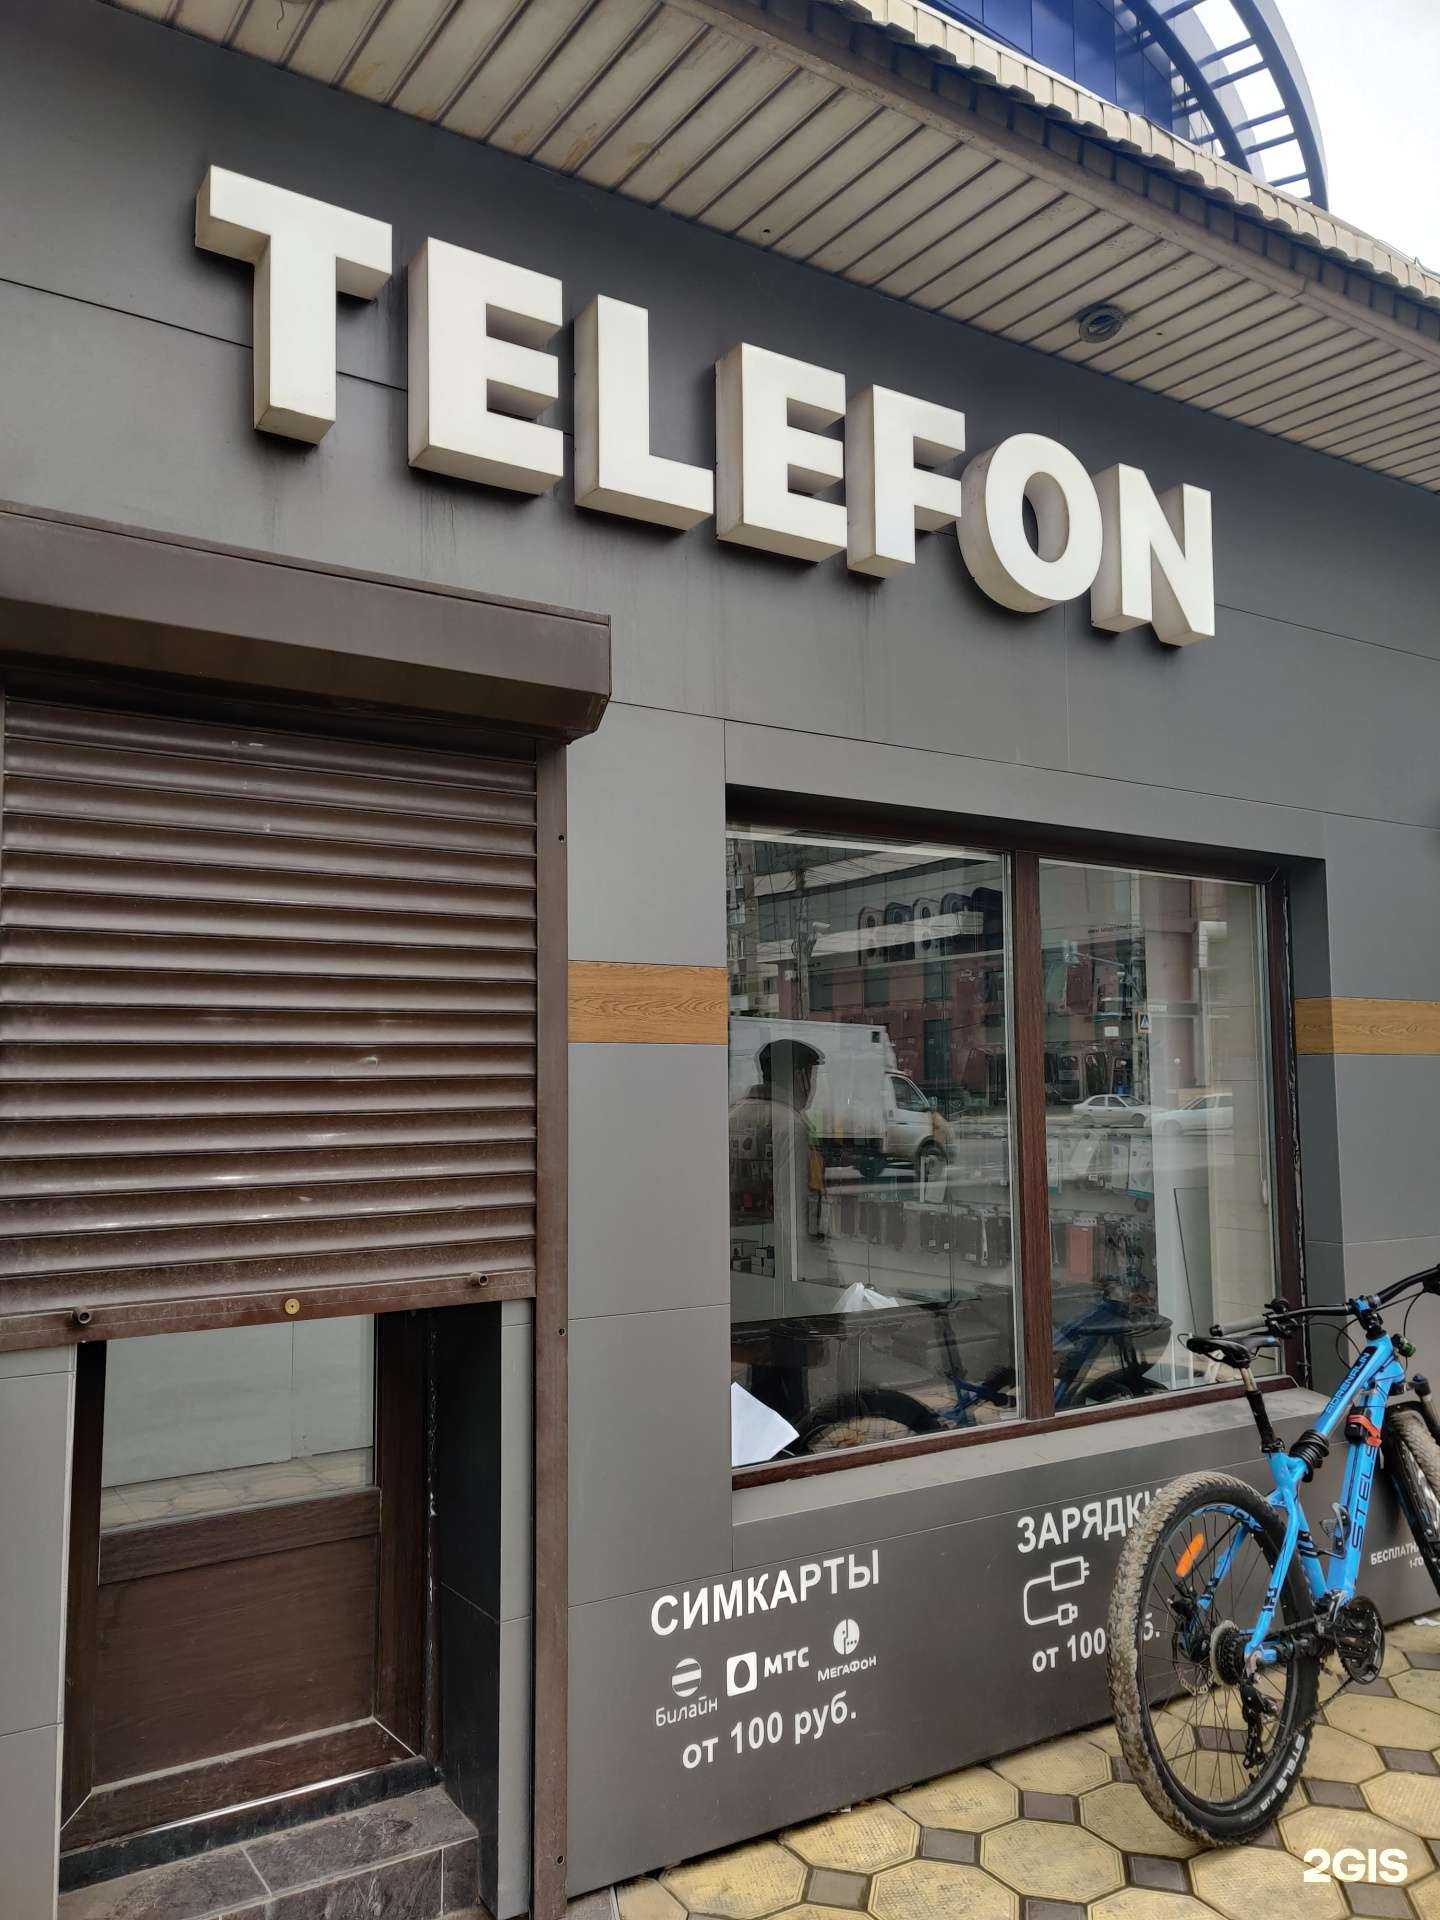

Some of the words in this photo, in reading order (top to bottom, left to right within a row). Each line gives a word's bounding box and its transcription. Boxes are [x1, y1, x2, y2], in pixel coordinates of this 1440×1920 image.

[197, 165, 1215, 646] TELEFON
[651, 1549, 879, 1636] СИМКАРТЫ
[764, 1647, 810, 1677] МТС
[1032, 1647, 1059, 1672] от
[1067, 1627, 1106, 1662] 100
[682, 1736, 719, 1769] от
[730, 1711, 783, 1754] 100
[794, 1690, 857, 1745] руб.
